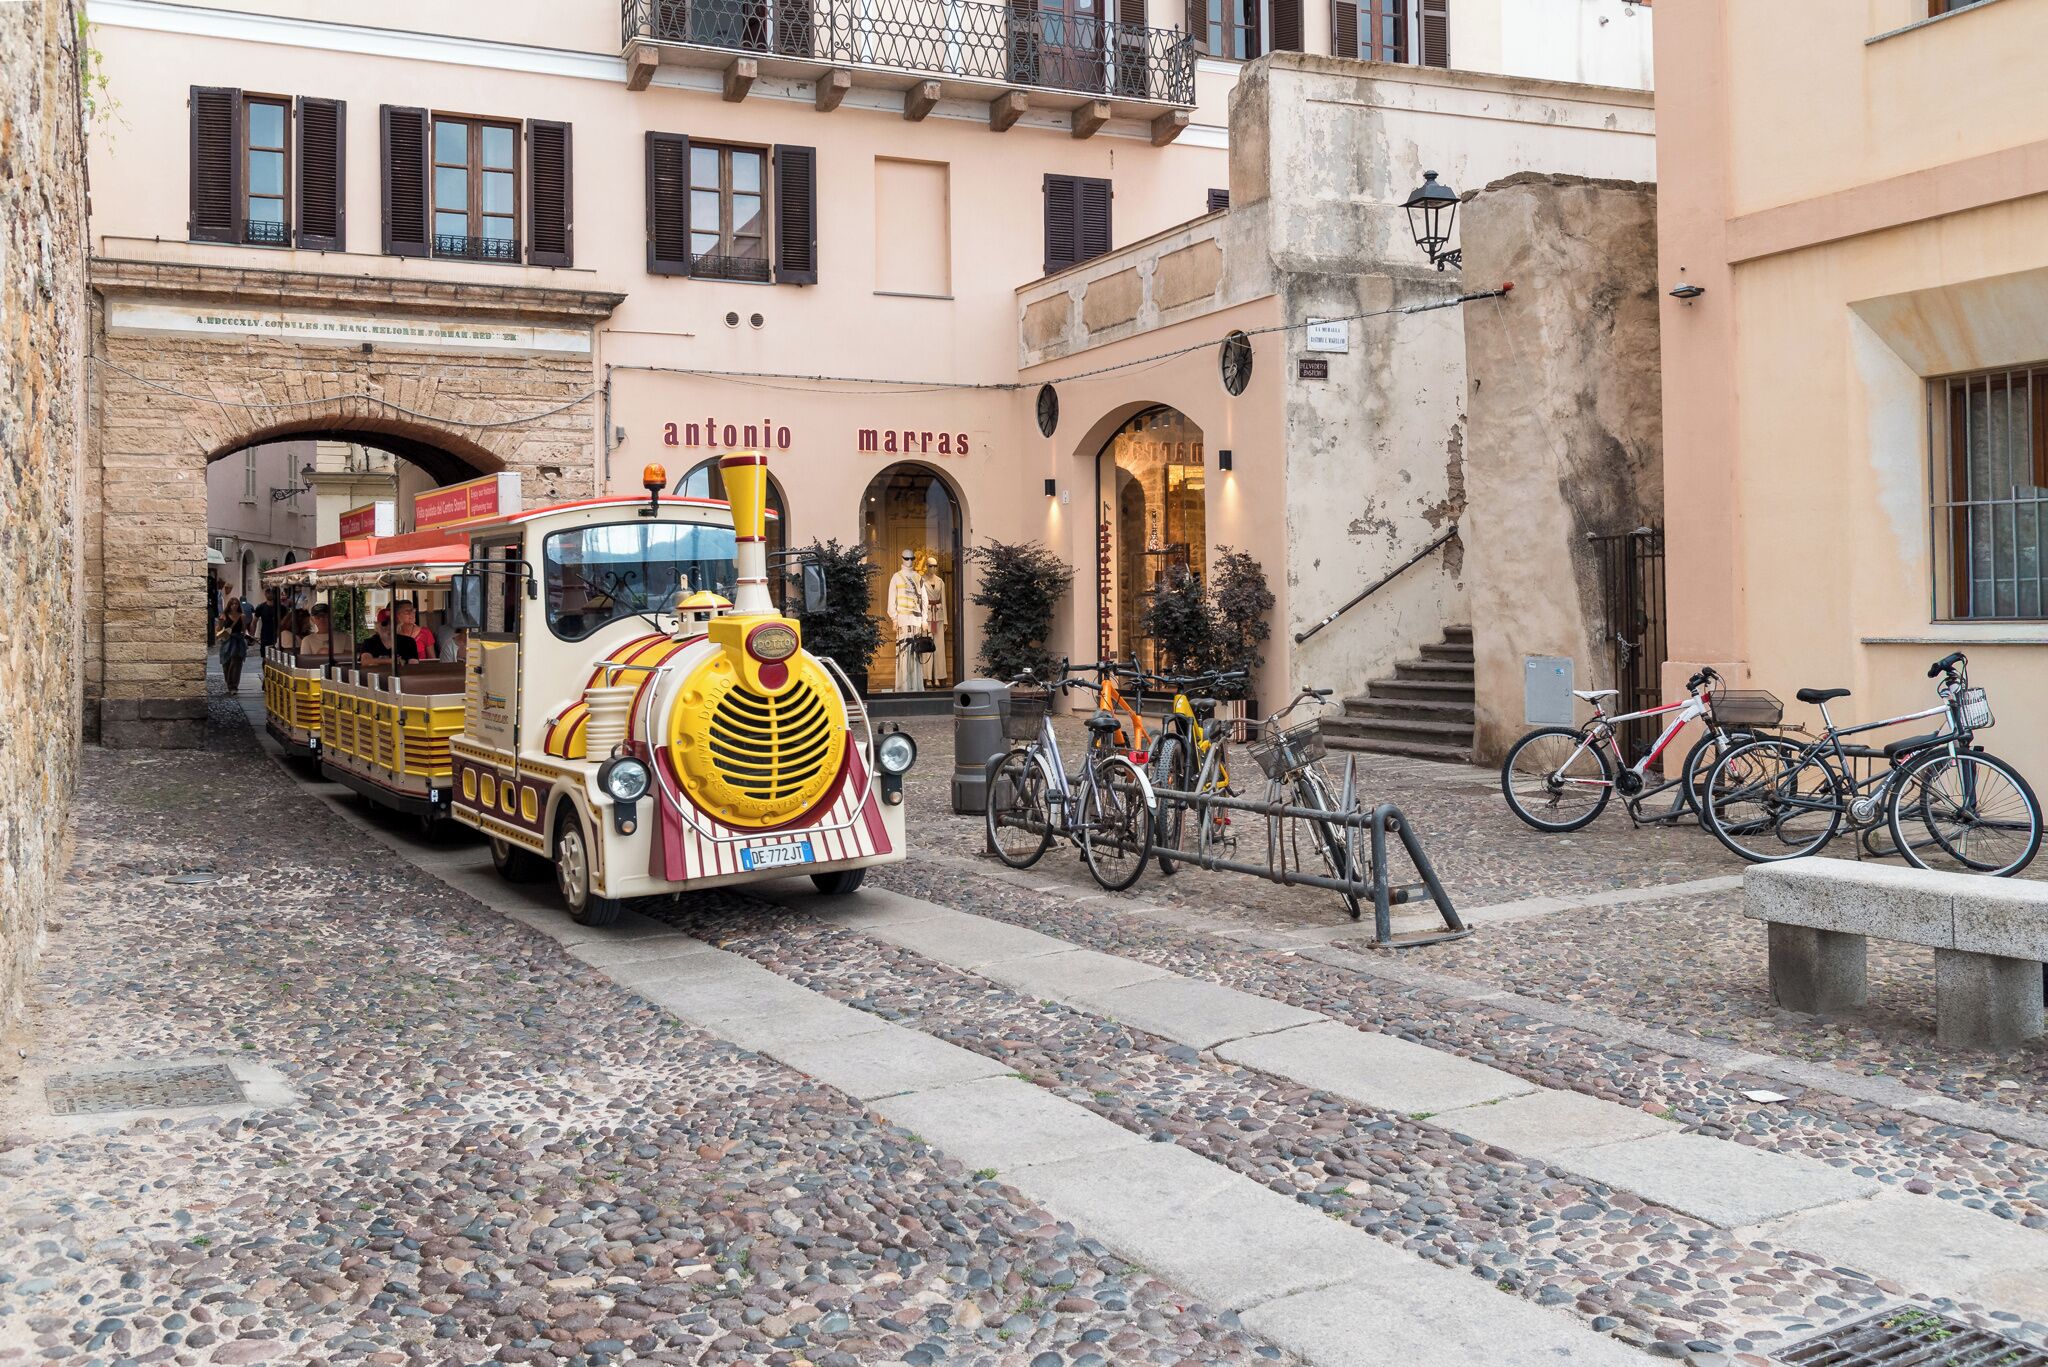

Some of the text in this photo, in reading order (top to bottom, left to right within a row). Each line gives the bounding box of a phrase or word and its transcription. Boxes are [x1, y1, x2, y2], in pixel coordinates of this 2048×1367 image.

[663, 417, 970, 456] antonio marras
[757, 638, 791, 649] DOTTO
